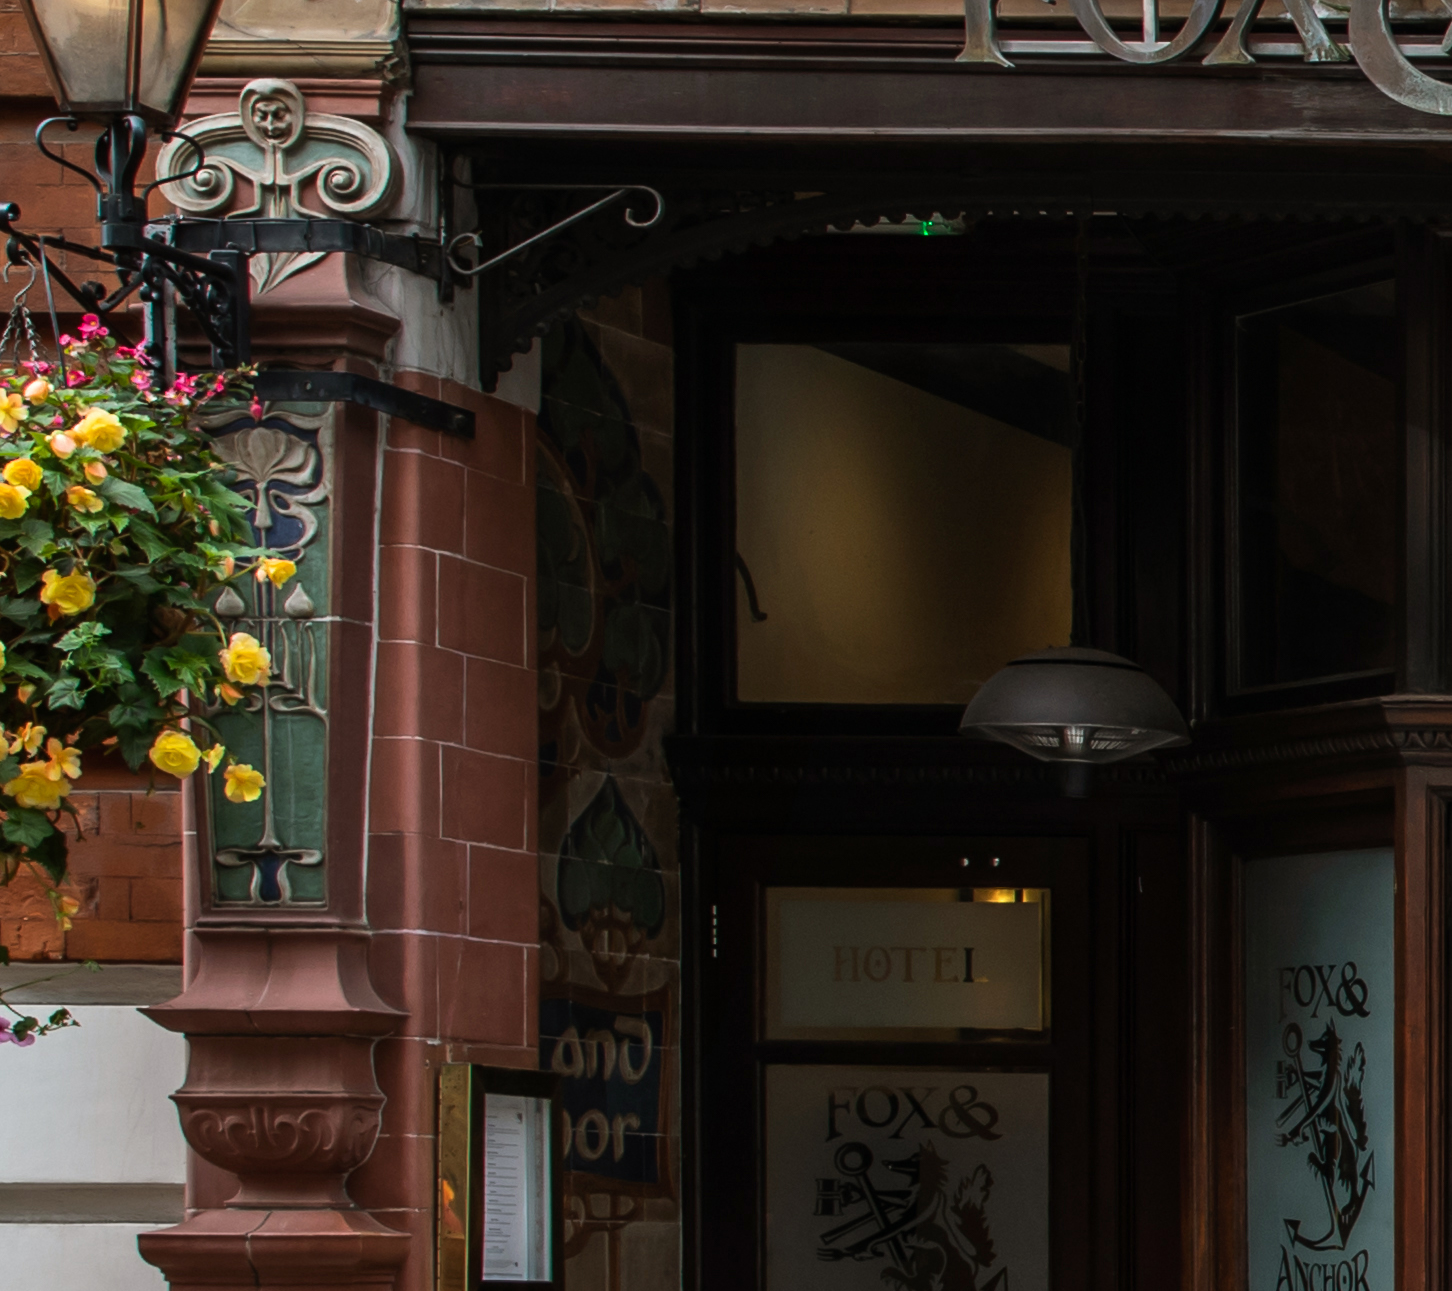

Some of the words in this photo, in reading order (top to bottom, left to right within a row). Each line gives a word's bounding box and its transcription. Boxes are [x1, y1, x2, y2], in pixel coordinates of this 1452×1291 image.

[833, 946, 990, 985] HOTEL
[1277, 963, 1338, 1024] FOX
[1333, 960, 1372, 1018] &
[825, 1085, 939, 1142] FOX
[938, 1084, 1003, 1141] &
